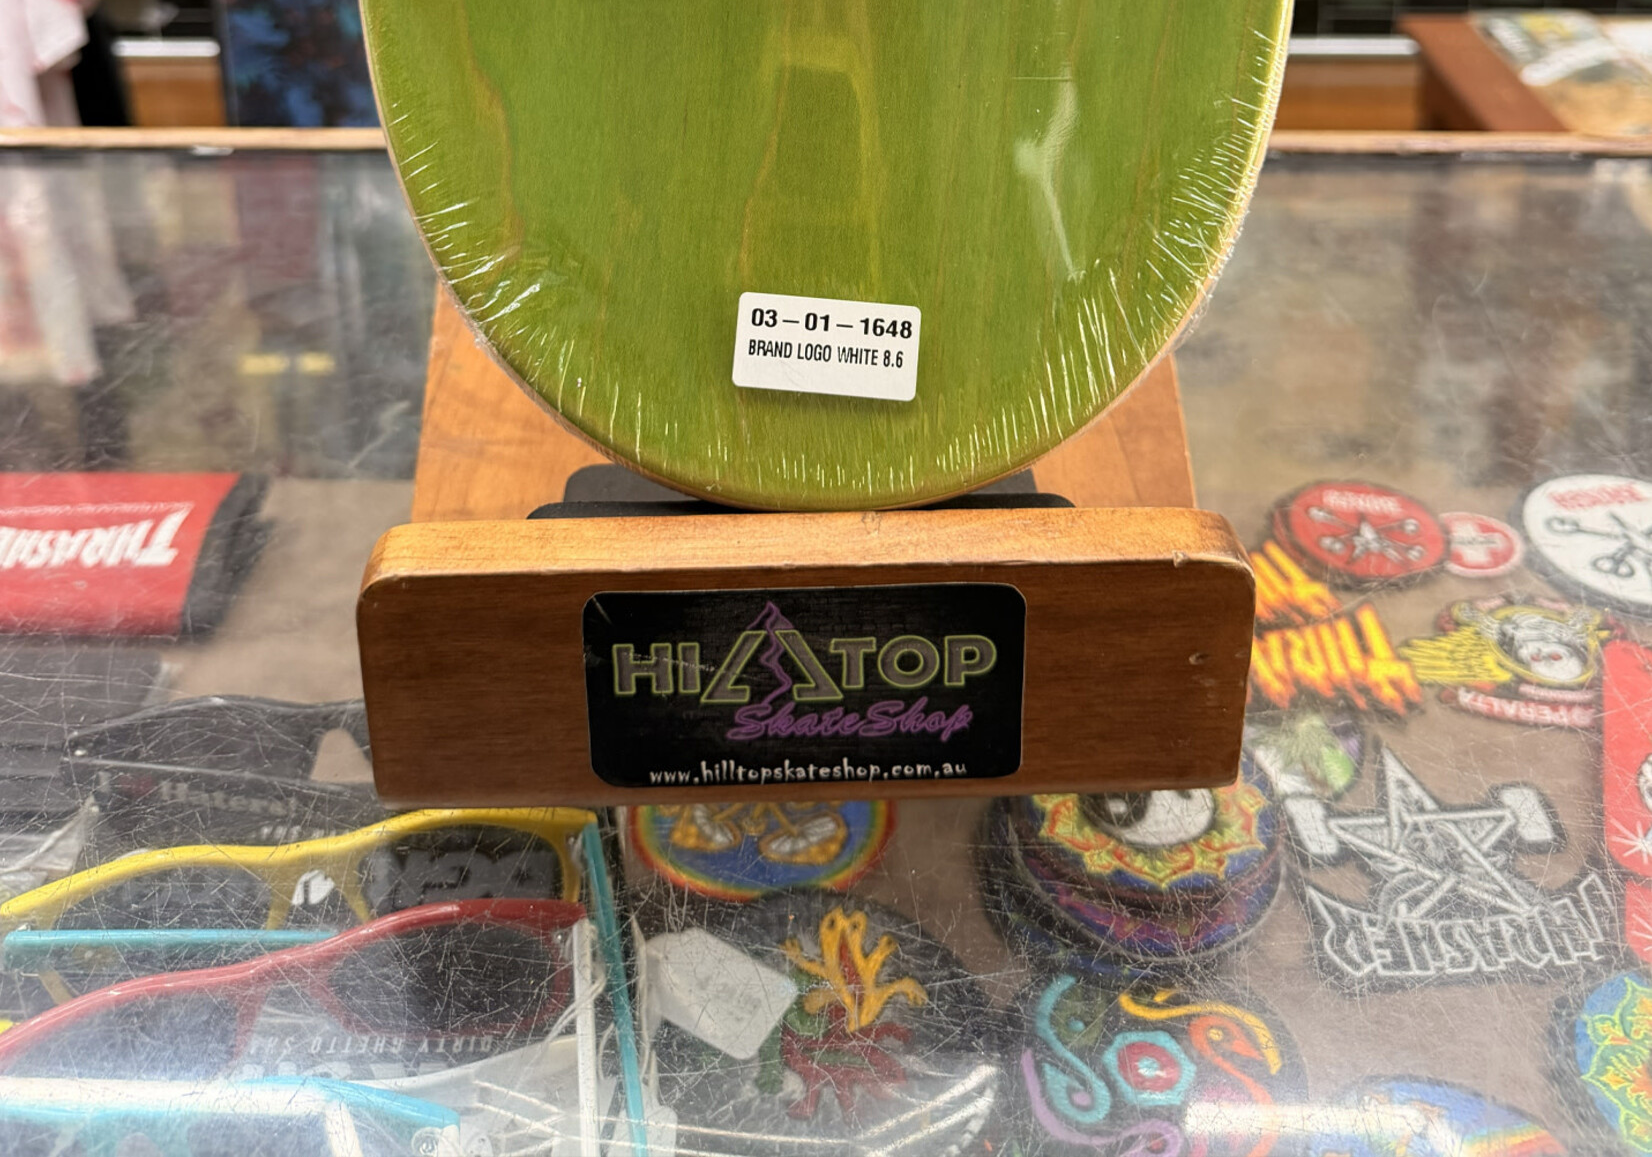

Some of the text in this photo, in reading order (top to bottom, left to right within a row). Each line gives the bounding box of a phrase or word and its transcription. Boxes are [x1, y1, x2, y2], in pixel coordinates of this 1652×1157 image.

[748, 339, 904, 369] BRAND LOGO WHITE 8.6
[1458, 685, 1571, 726] PERALTA
[649, 756, 968, 785] www.hilltopskateshop.com.au
[1305, 872, 1613, 978] THRASHER
[309, 1034, 405, 1054] GHETTO
[417, 1034, 493, 1054] DIRTY
